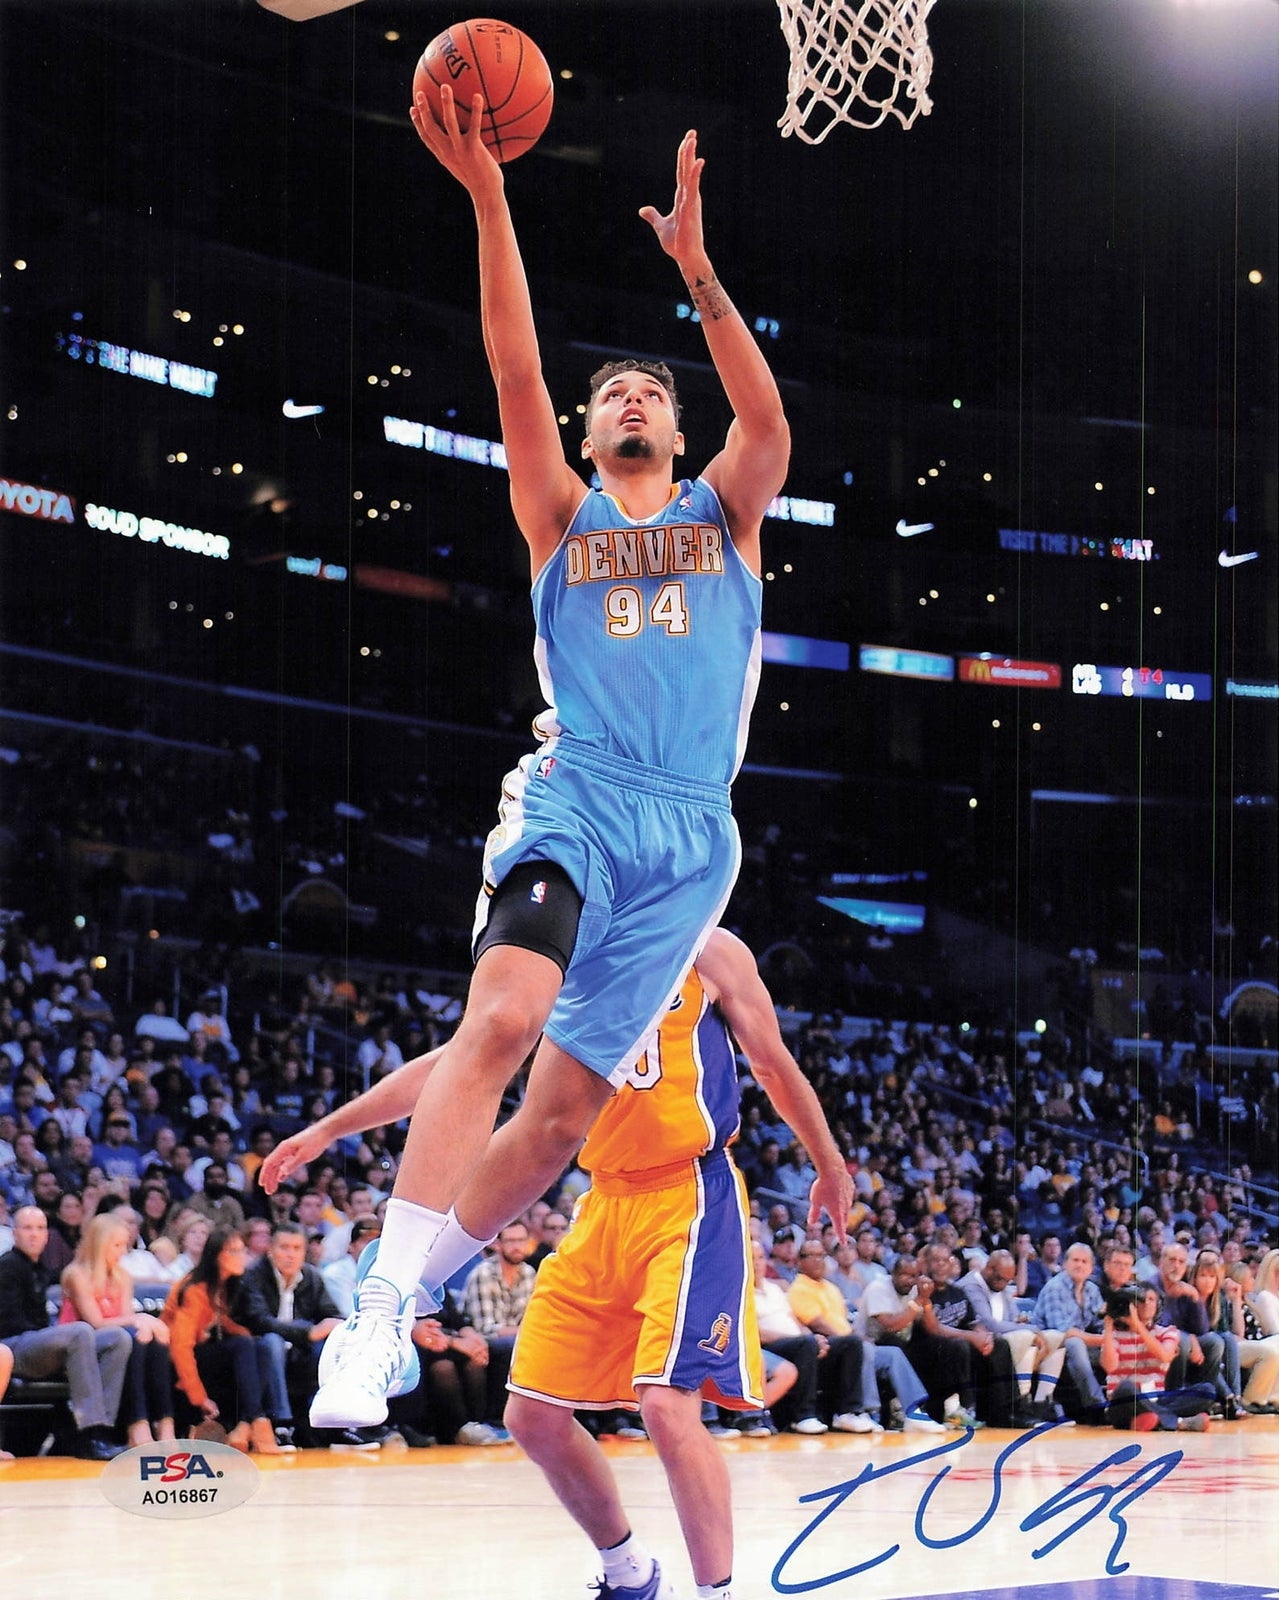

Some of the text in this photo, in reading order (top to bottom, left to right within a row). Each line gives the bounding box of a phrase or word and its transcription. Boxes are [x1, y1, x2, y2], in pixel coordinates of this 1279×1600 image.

[0, 480, 75, 523] YOTA
[566, 524, 724, 587] DENVER
[605, 582, 689, 638] 94
